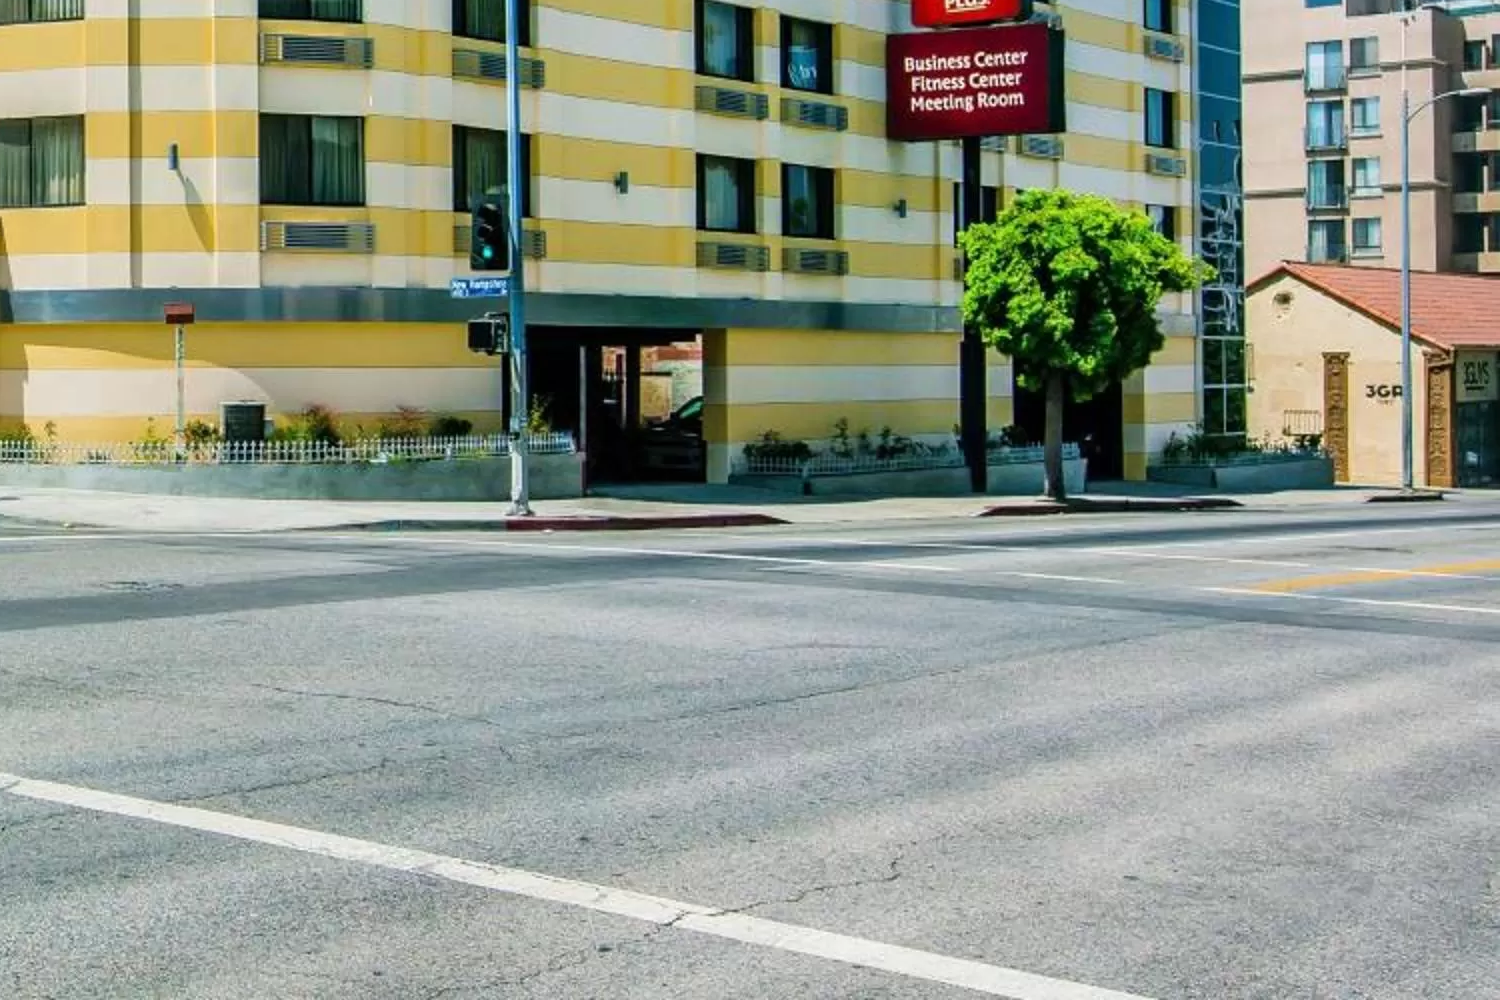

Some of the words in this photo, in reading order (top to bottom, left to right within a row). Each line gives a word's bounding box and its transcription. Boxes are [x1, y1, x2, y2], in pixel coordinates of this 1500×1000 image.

[904, 54, 972, 73] Business
[973, 50, 1028, 68] Center
[911, 75, 966, 92] Fitness
[969, 72, 1023, 89] Center
[911, 93, 975, 113] Meeting
[977, 91, 1025, 109] Room
